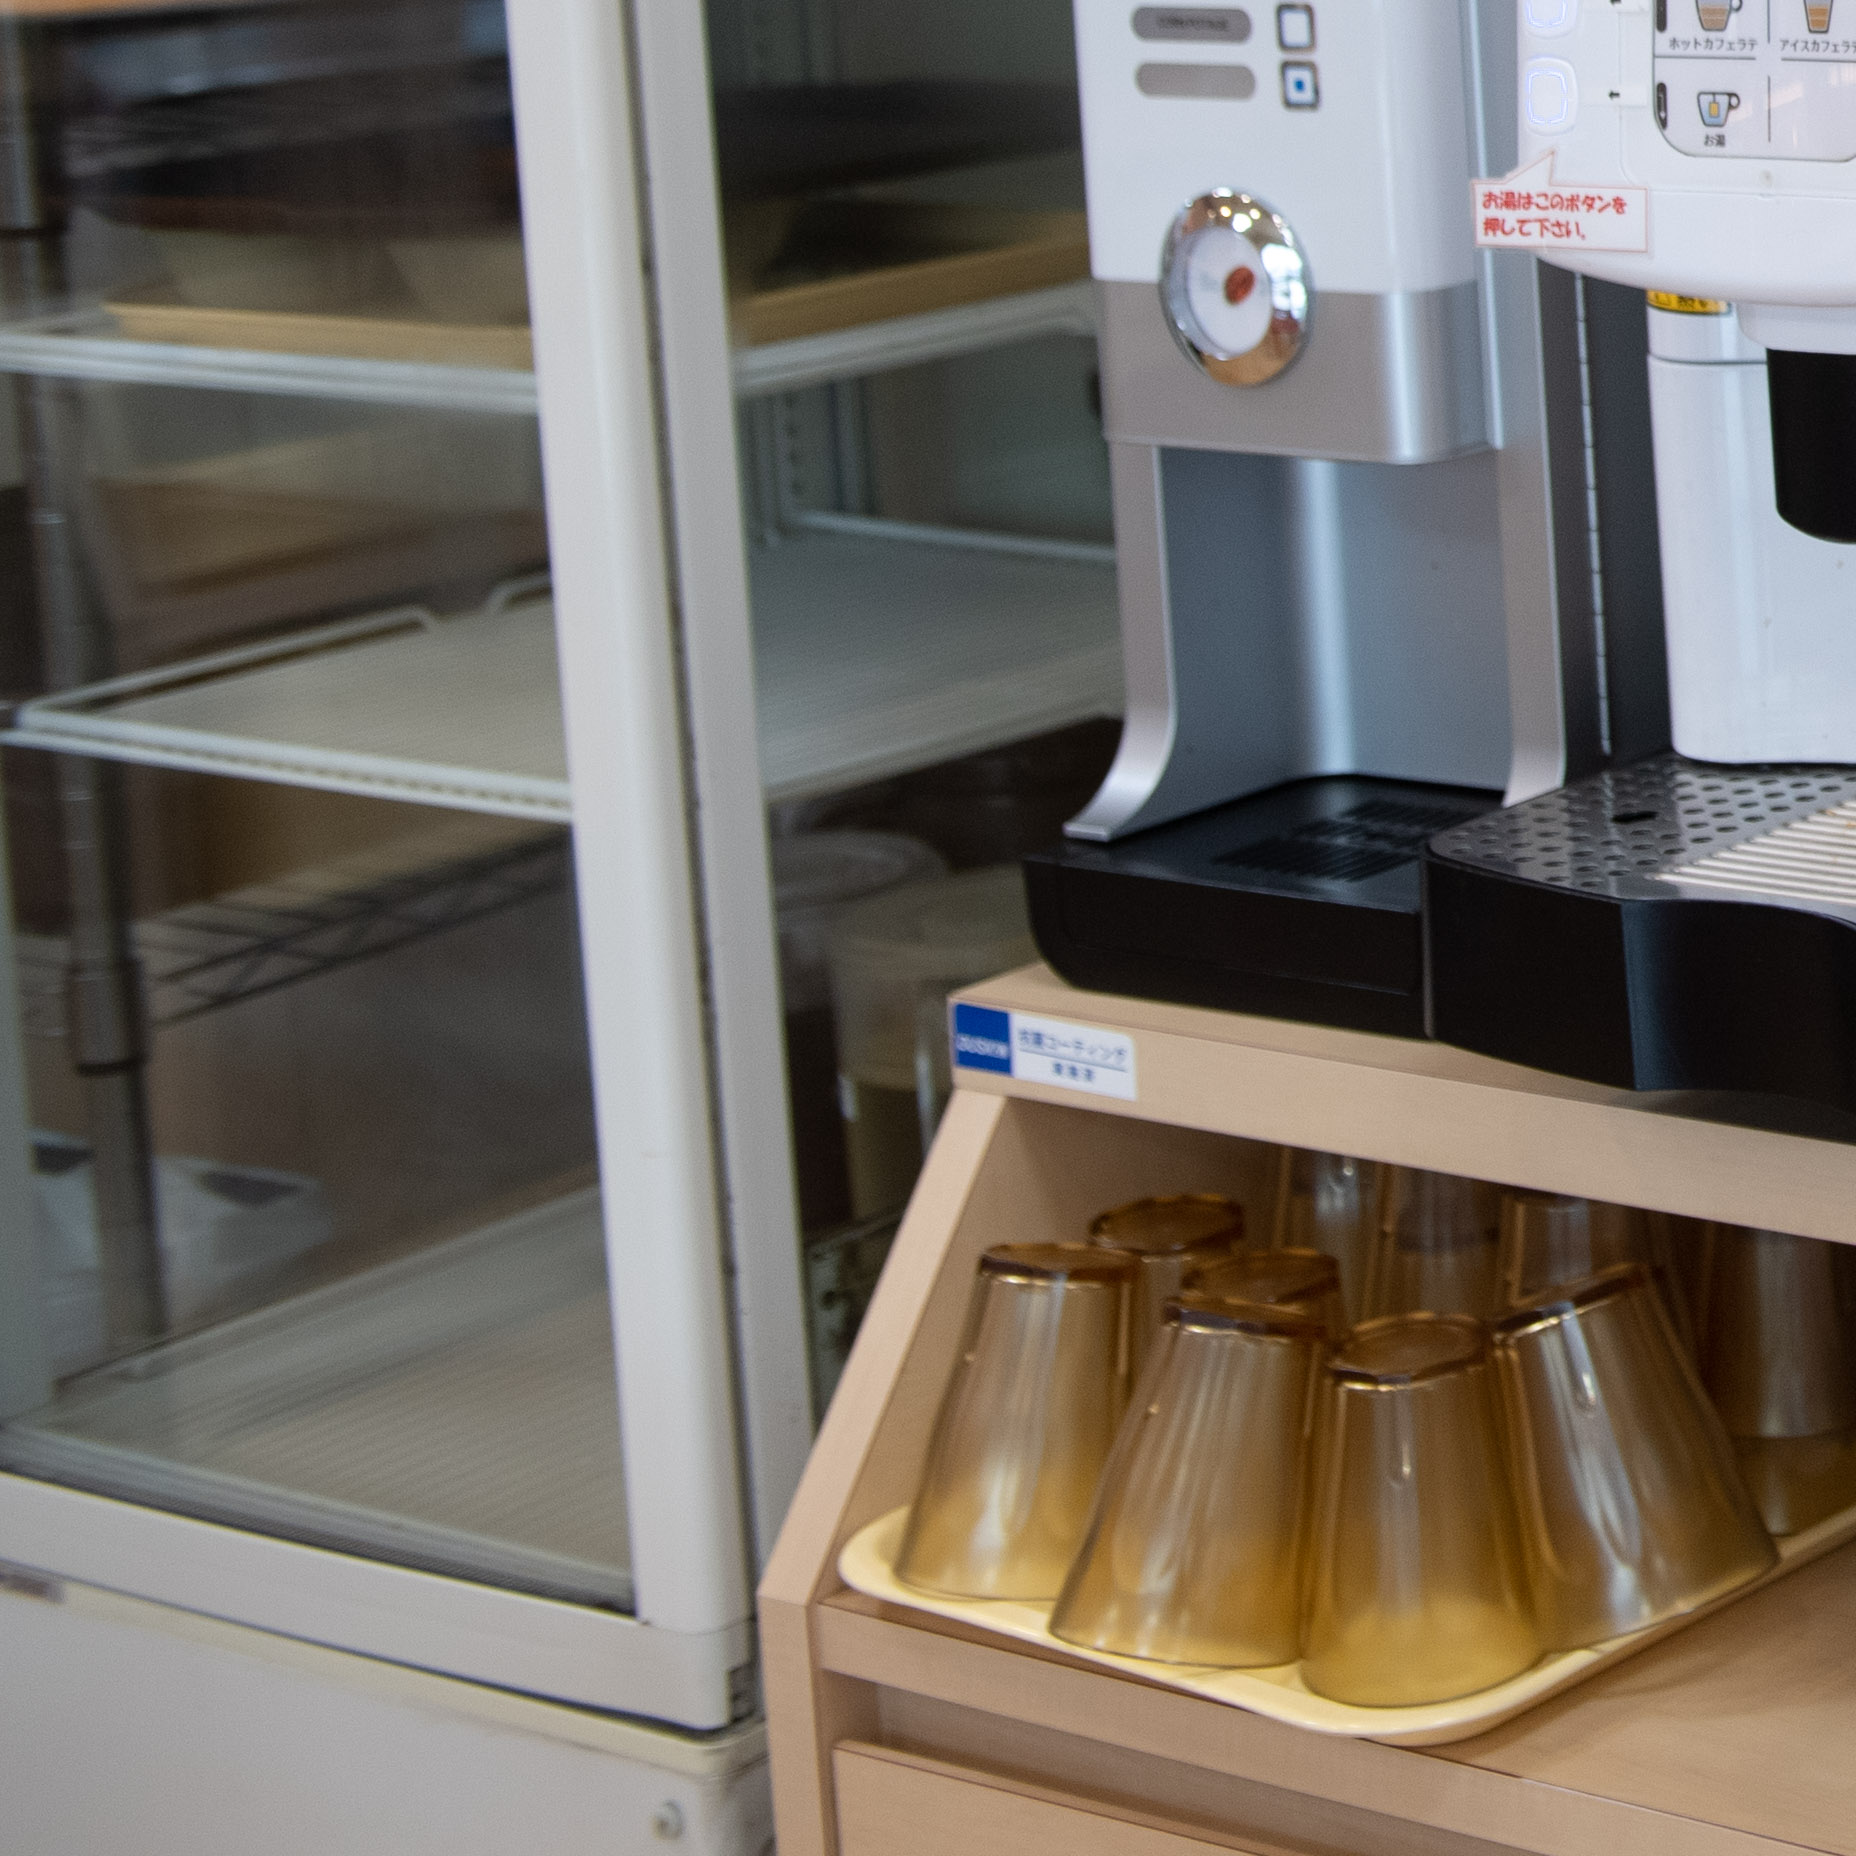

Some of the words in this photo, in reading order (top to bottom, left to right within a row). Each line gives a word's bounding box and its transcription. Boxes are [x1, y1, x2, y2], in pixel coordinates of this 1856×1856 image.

[1668, 37, 1759, 52] ホットカフェラテ
[1703, 134, 1726, 148] お湯
[1482, 191, 1627, 215] お湯はこのボタンを
[1483, 216, 1586, 241] 押して下さい。
